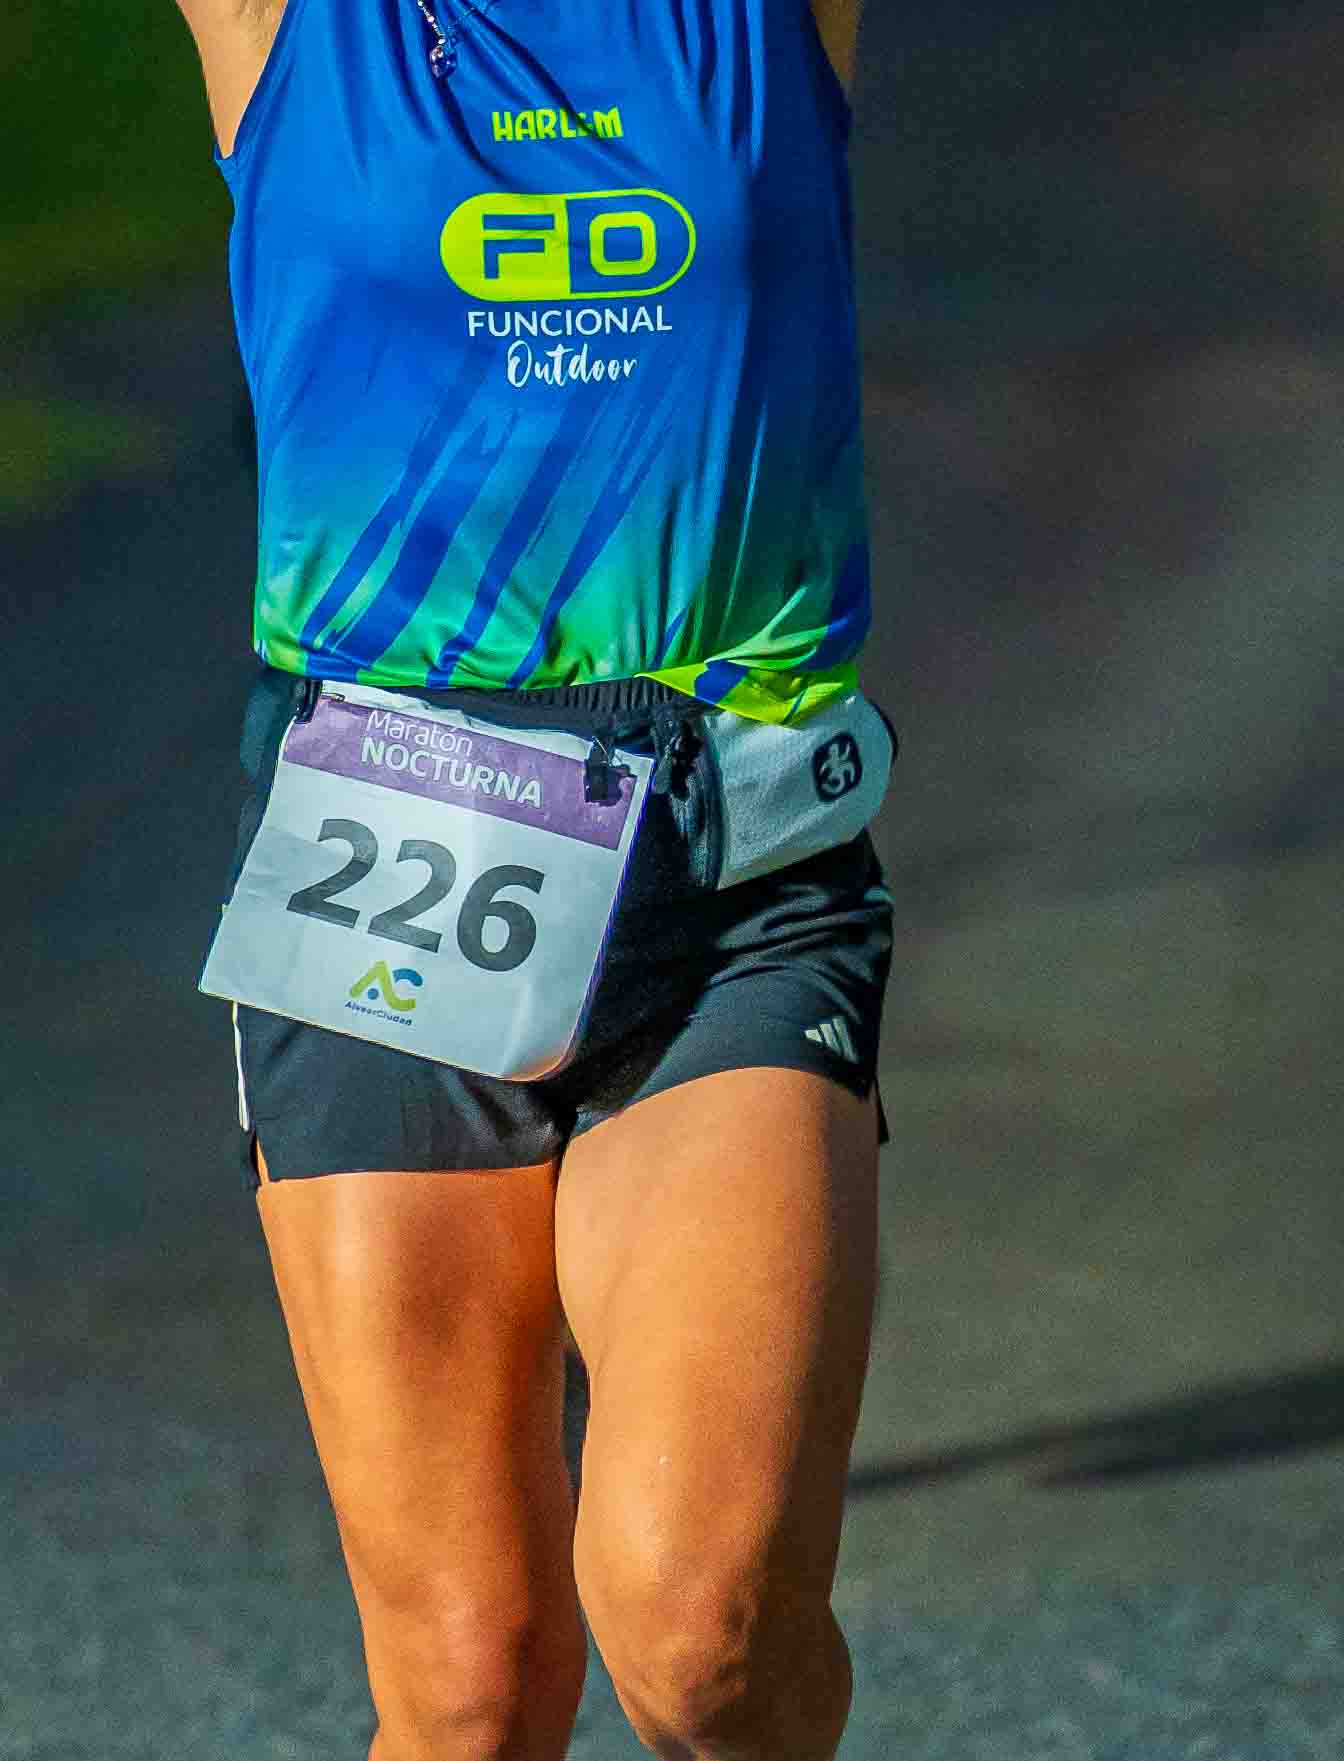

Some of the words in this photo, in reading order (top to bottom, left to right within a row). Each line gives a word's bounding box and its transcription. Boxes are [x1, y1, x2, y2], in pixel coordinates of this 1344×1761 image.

[467, 305, 673, 337] FUNCIONAL
[507, 340, 638, 388] Outdoor
[366, 709, 473, 757] Maratón
[361, 736, 543, 809] NOCTURNA
[286, 818, 545, 972] 226
